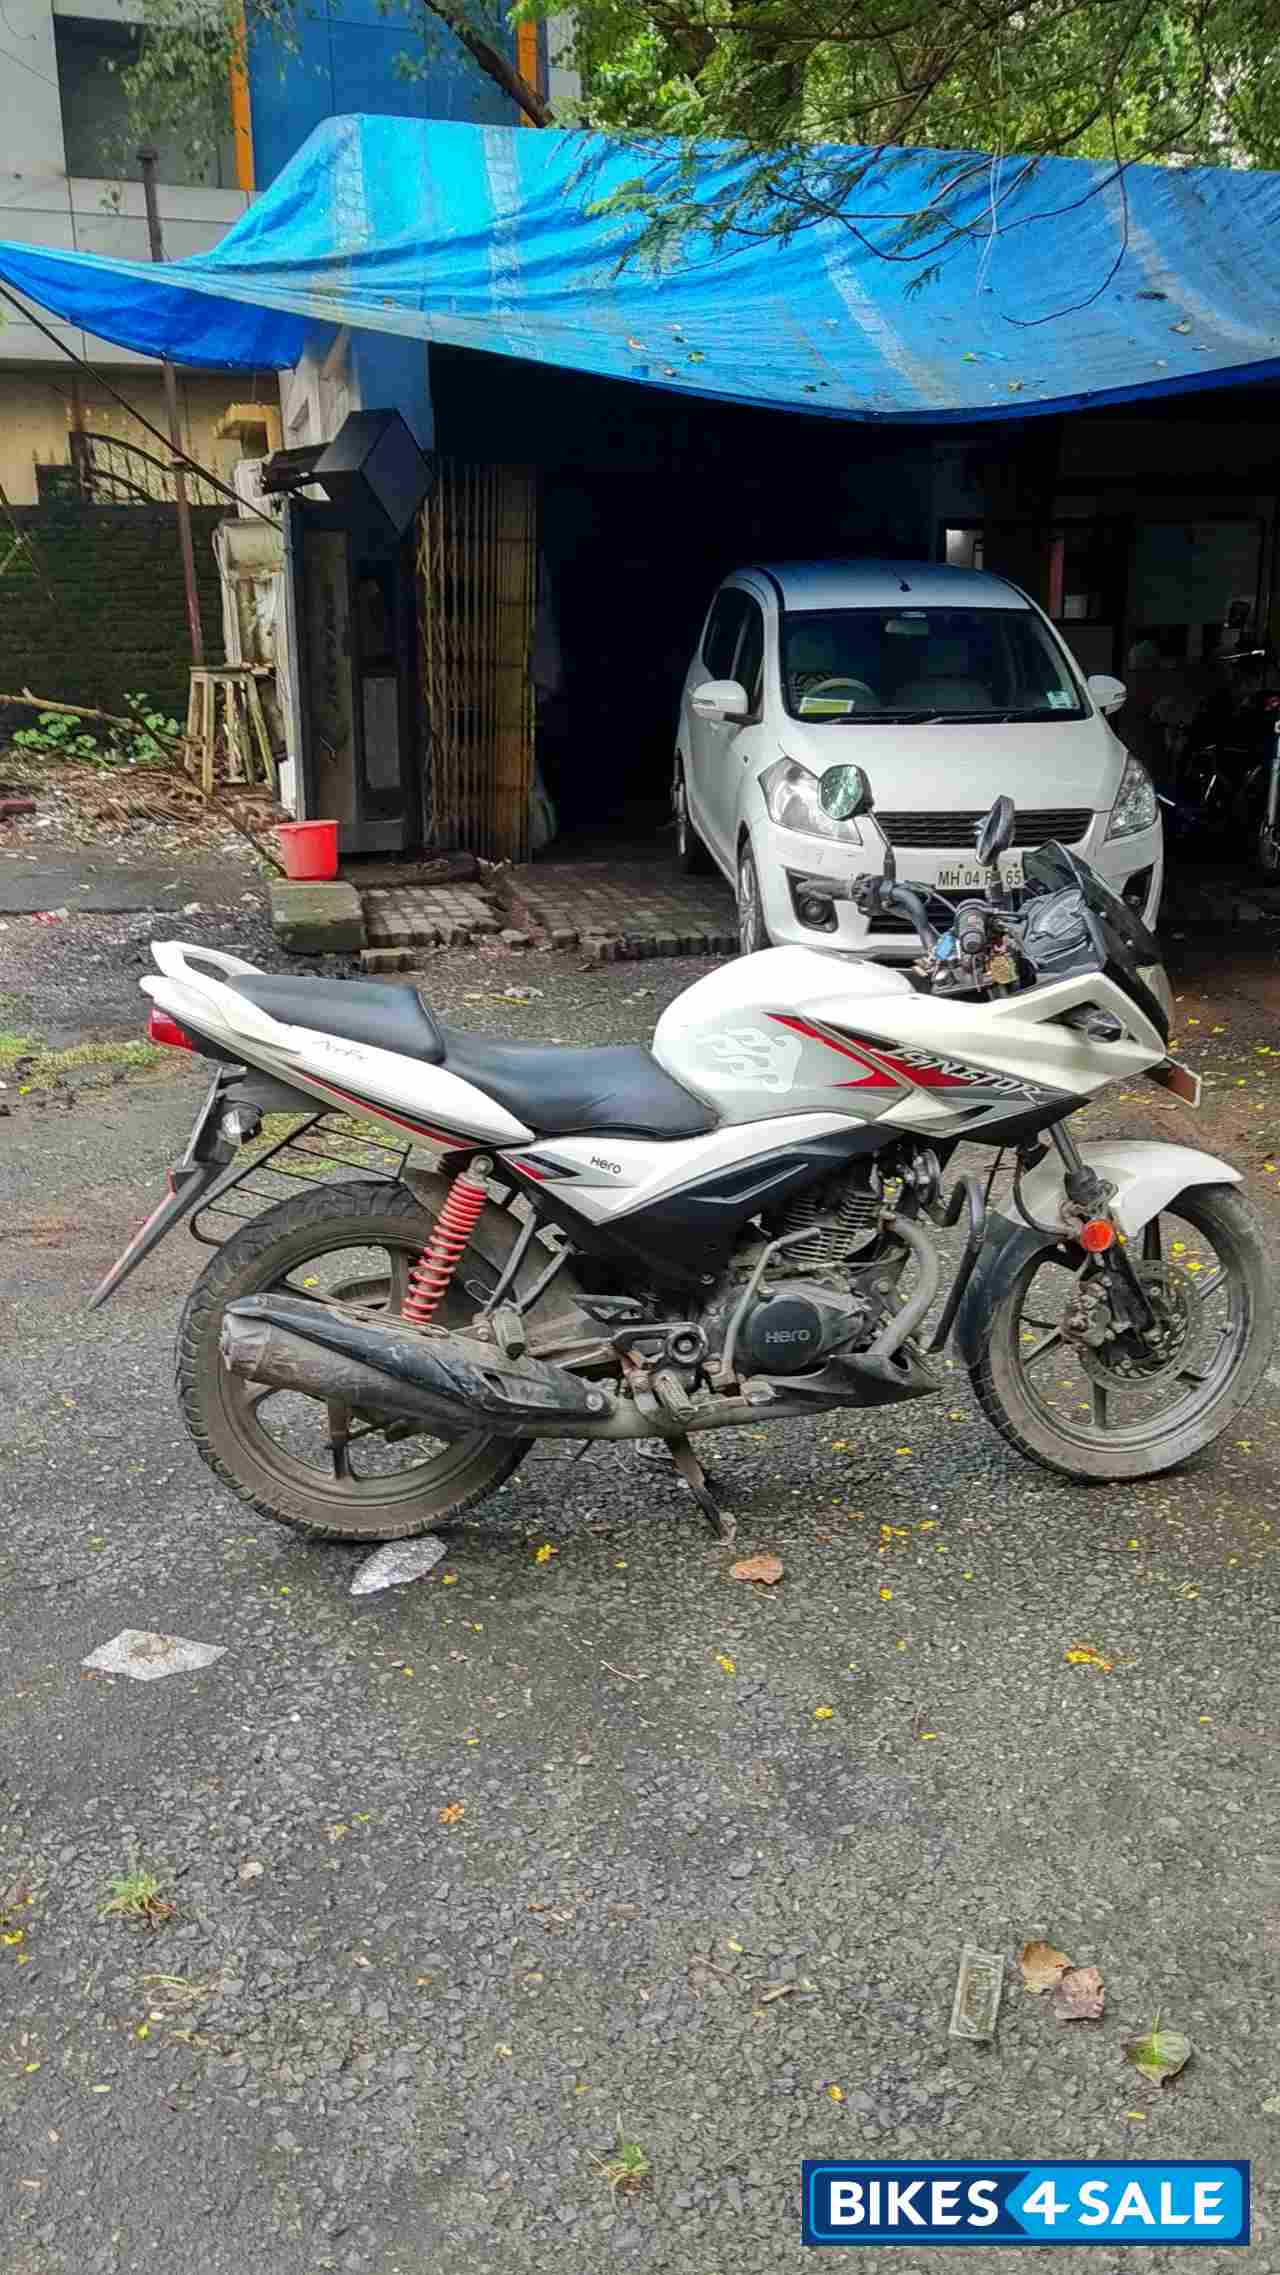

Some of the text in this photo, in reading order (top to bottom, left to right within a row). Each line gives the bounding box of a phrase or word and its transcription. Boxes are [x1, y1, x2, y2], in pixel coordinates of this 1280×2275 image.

[937, 871, 960, 887] MH
[964, 871, 980, 886] 04
[590, 1155, 622, 1175] Hero
[765, 1329, 811, 1343] Hero
